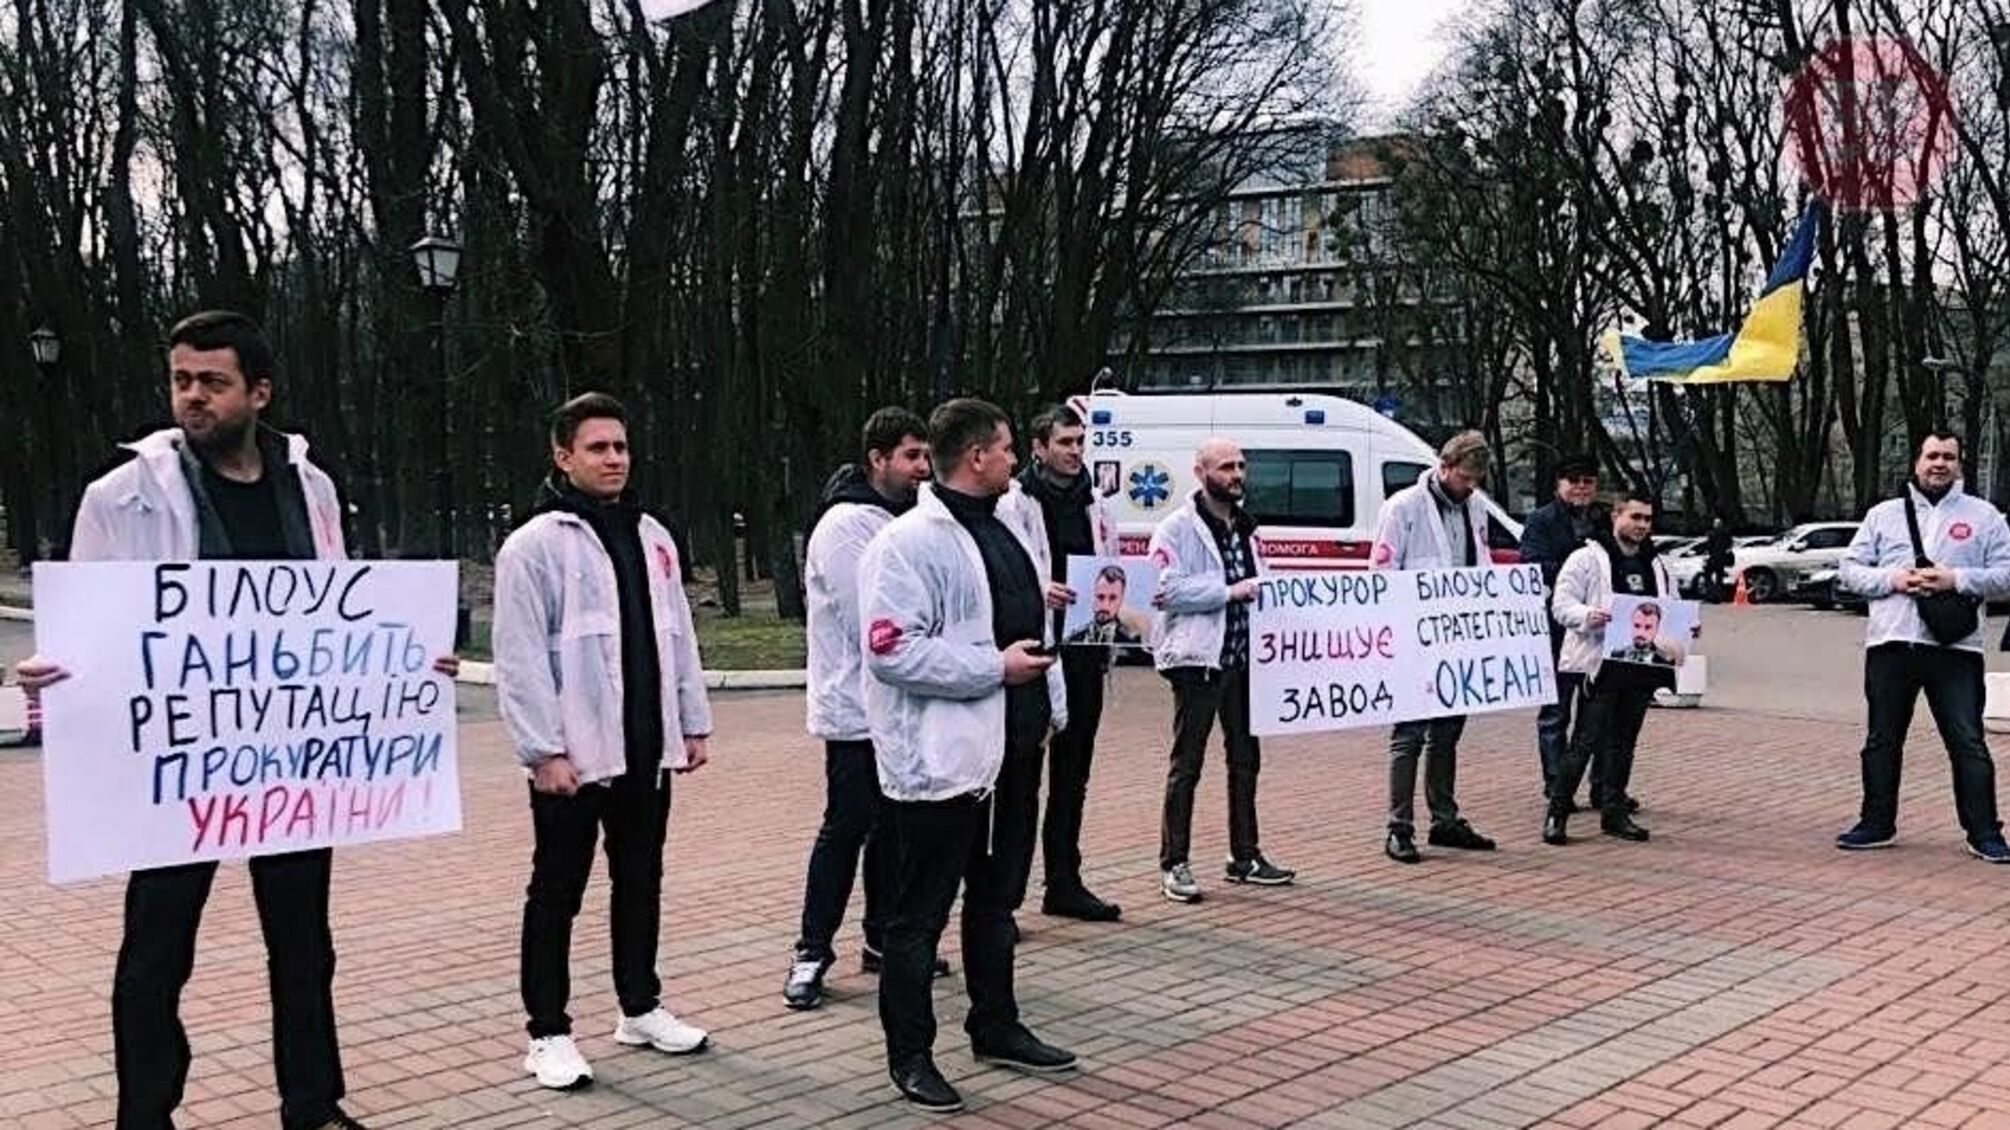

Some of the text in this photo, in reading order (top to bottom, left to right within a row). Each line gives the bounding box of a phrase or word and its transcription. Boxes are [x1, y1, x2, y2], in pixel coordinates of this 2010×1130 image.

[1092, 431, 1133, 447] 355
[154, 562, 373, 623] БІЛОУС
[1257, 573, 1389, 612] ПРОКУРОР
[1416, 569, 1499, 601] БІЛОУС
[141, 622, 427, 690] ГАНЬБИТЬ
[1257, 624, 1395, 664] ЗНИЩУЄ
[129, 676, 440, 753] РЕПУТАЦІЮ
[1278, 679, 1393, 722] ЗАВОД
[152, 732, 444, 805] ПРОКУРАТУРИ
